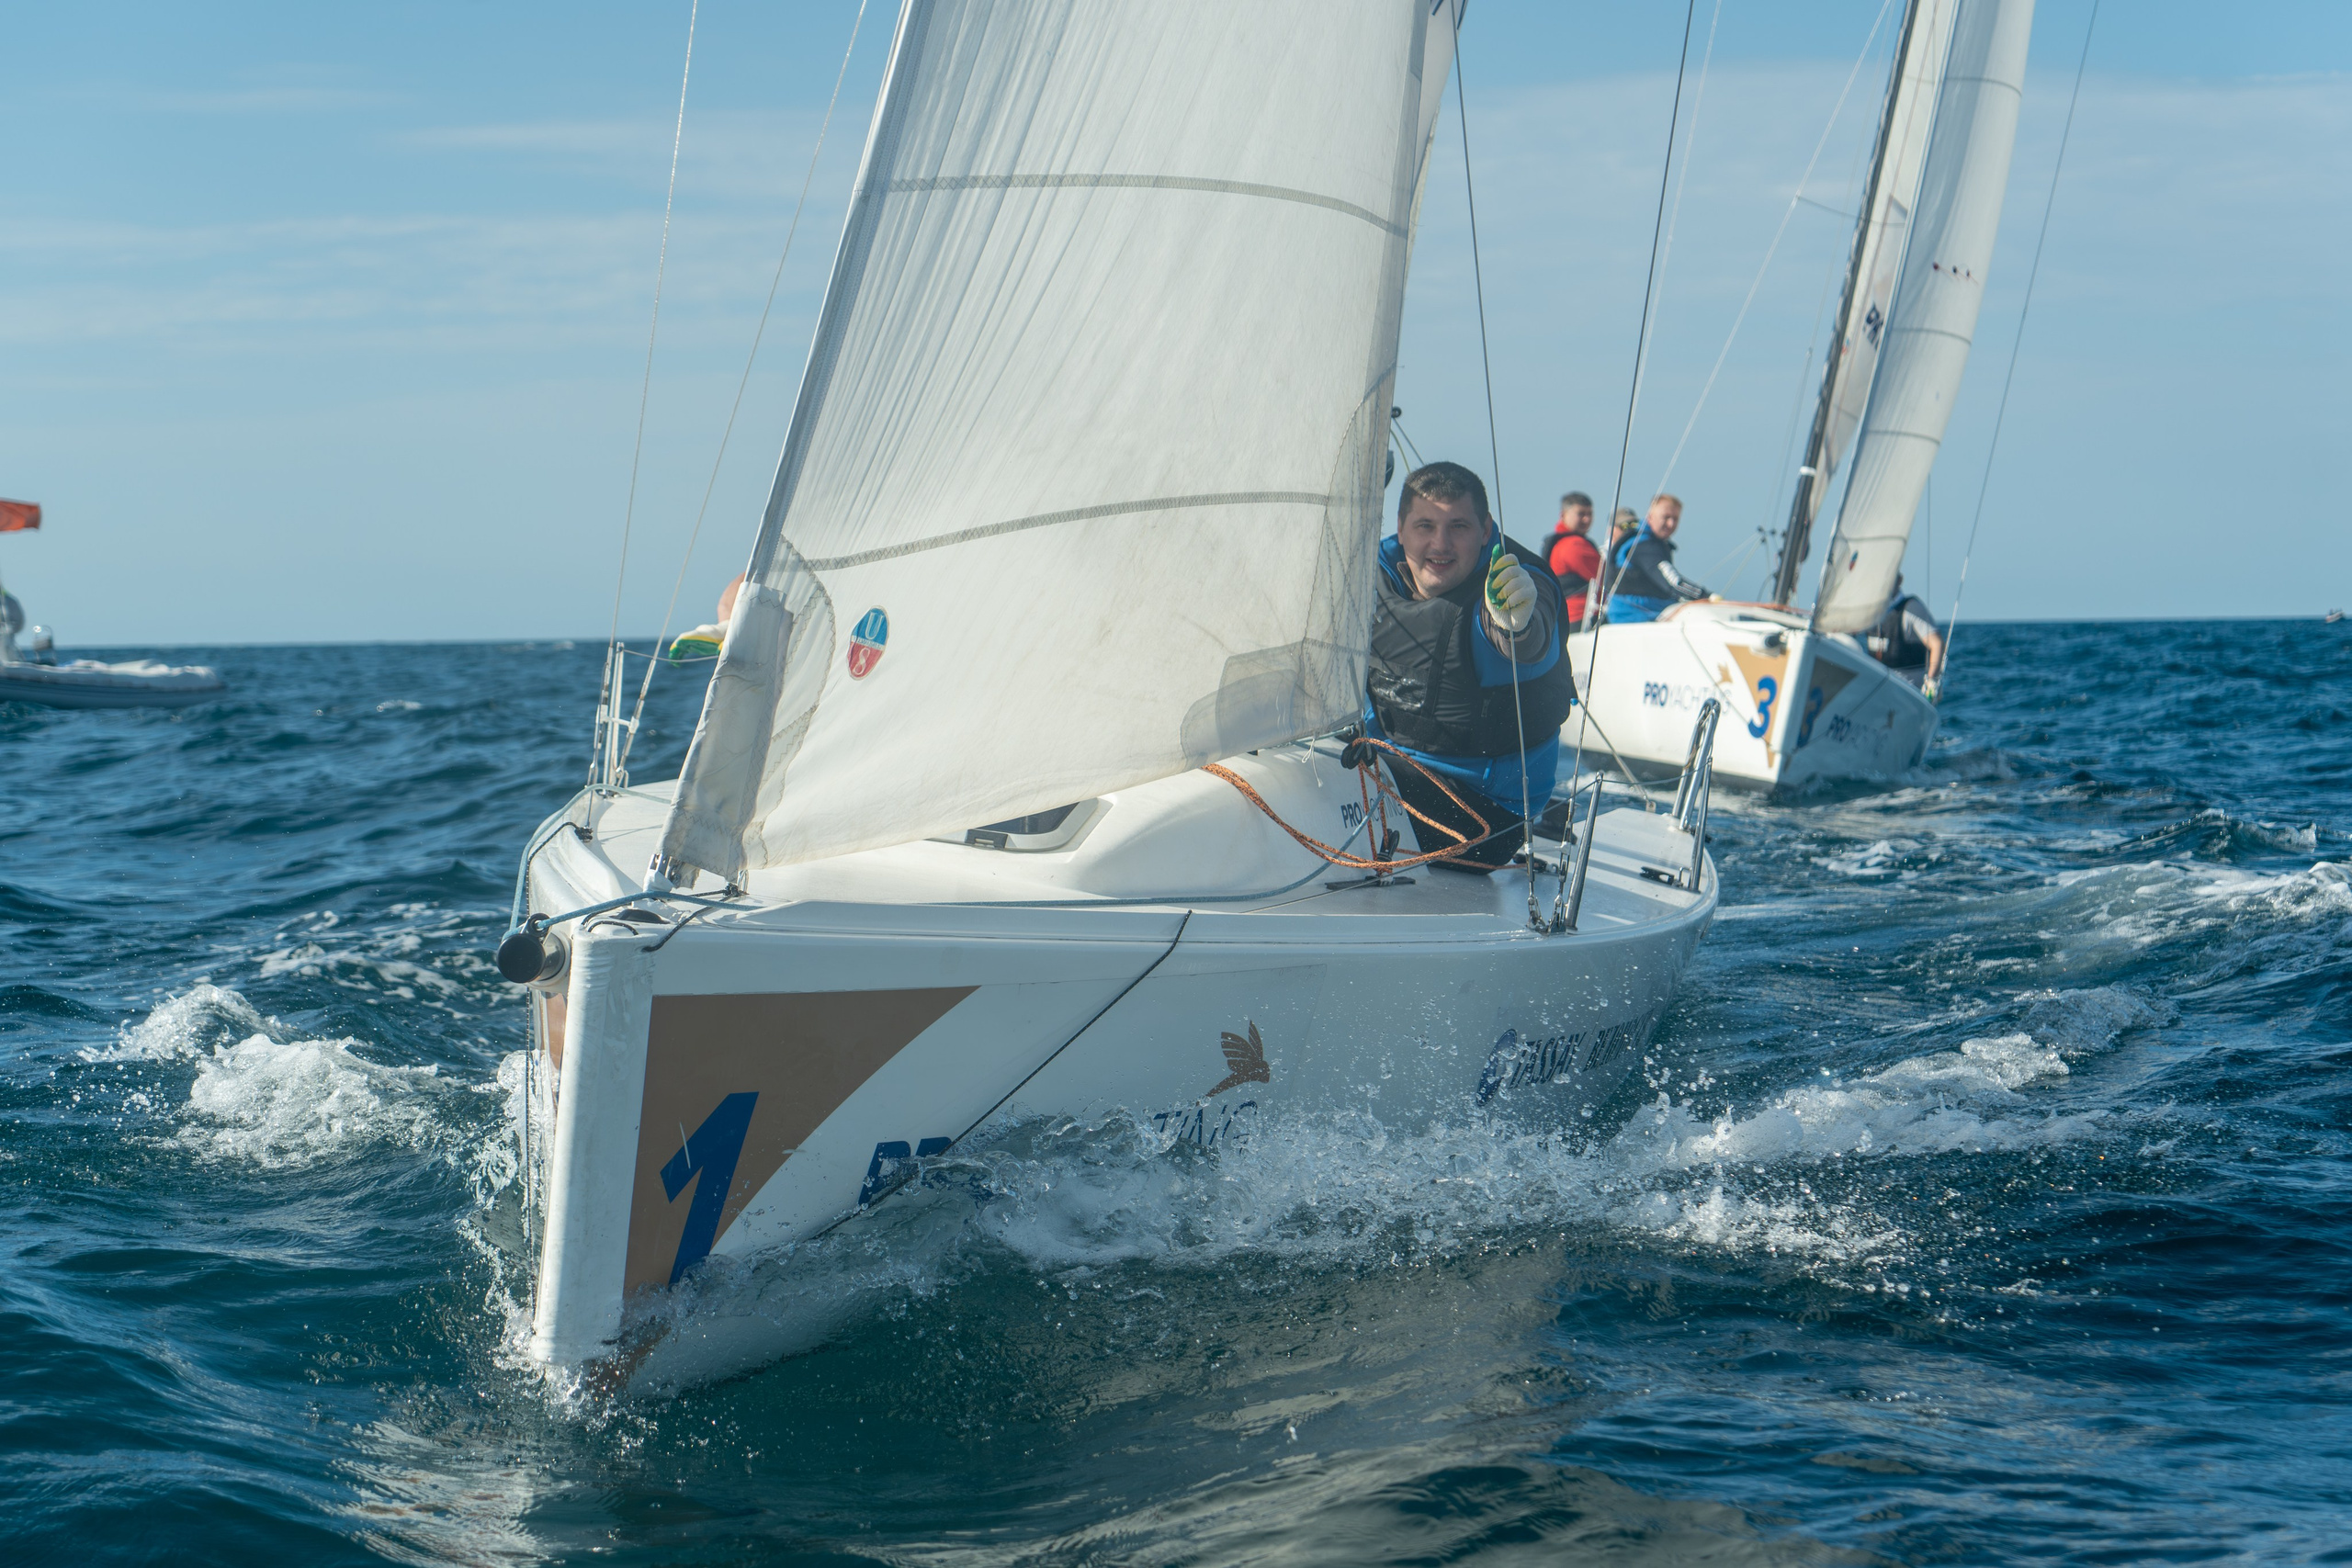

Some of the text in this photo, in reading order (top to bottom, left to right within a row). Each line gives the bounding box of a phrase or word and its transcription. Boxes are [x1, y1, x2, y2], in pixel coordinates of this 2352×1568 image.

[1747, 675, 1777, 739] 3
[1796, 685, 1823, 749] 3
[1508, 1031, 1588, 1089] TASSAY
[659, 1091, 760, 1288] 1
